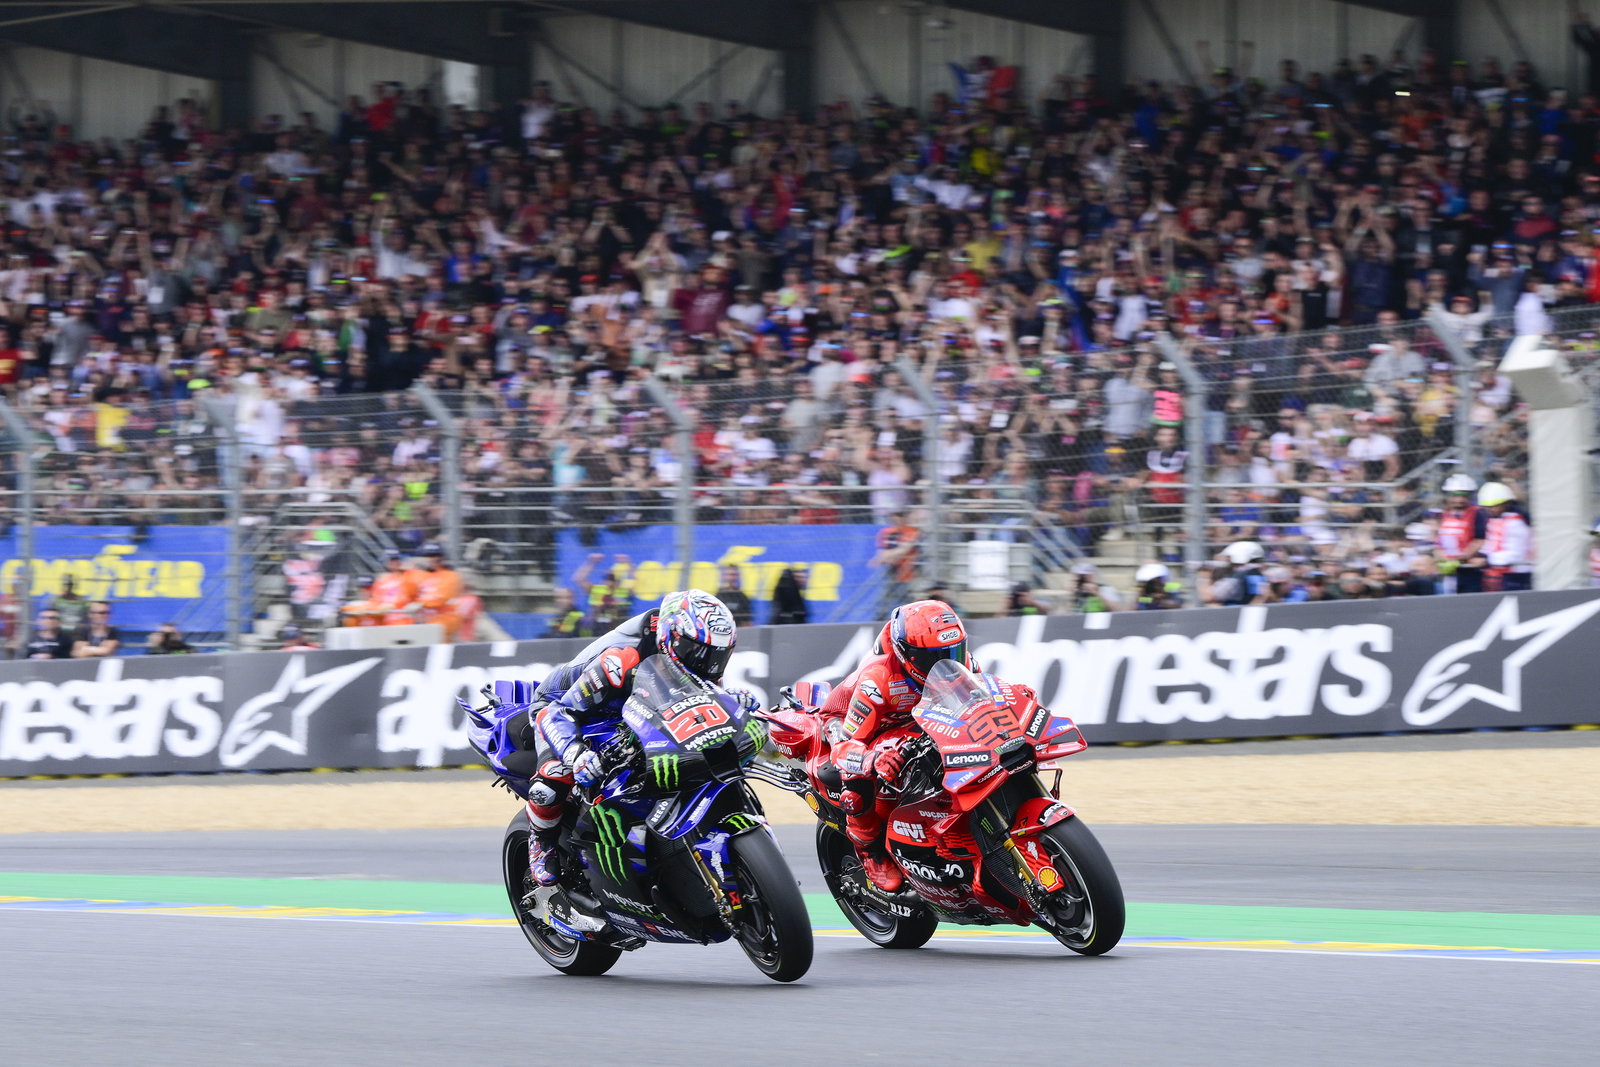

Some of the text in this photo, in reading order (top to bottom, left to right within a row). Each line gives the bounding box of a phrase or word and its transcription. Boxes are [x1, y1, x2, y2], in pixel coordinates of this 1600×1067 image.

[941, 630, 959, 640] SHOEI
[671, 695, 713, 714] ENEOS
[541, 712, 567, 752] YAMAHA
[663, 701, 730, 744] 20
[967, 705, 1020, 746] 93
[1025, 708, 1047, 738] Lenovo
[685, 725, 737, 751] MONSTER
[696, 734, 734, 752] ENERGY
[946, 753, 989, 765] Lenovo
[959, 771, 975, 783] TIM
[977, 764, 1004, 784] CARRERA
[827, 788, 841, 800] Len
[892, 819, 927, 839] GIVI
